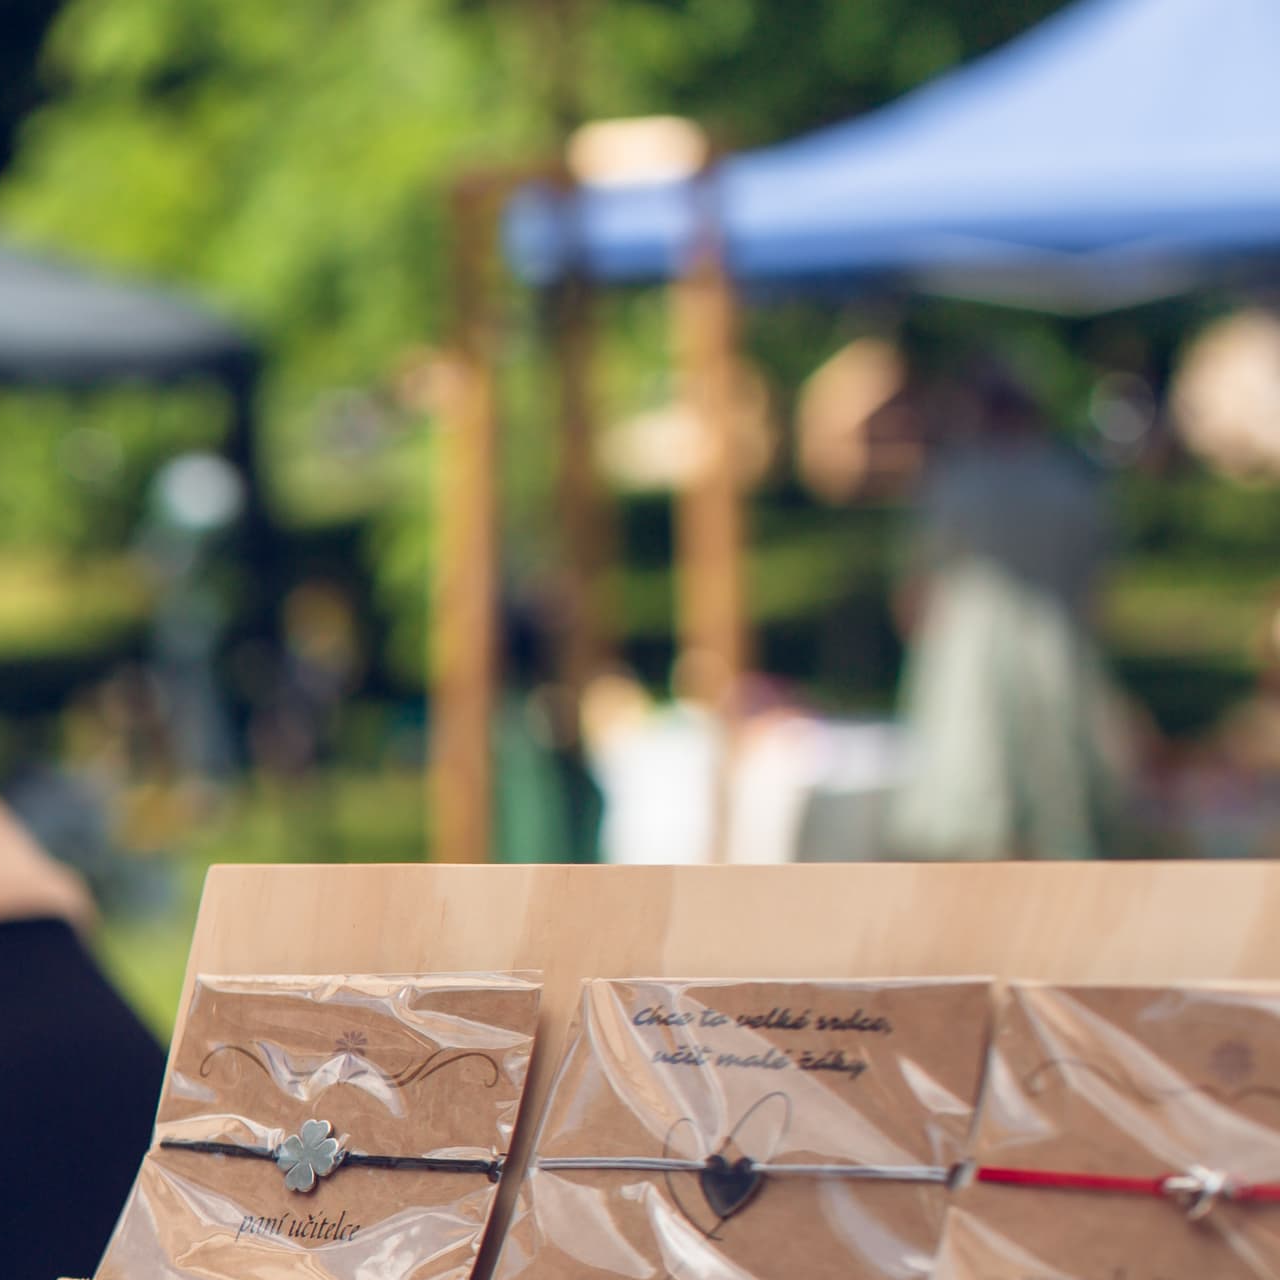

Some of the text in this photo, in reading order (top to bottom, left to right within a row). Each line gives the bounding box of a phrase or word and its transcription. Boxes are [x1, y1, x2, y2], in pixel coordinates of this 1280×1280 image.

[633, 1004, 692, 1027] Chce
[737, 1007, 810, 1031] velké
[715, 1048, 791, 1070] malé
[798, 1050, 868, 1080] žáky
[234, 1209, 361, 1243] paní učitelce
